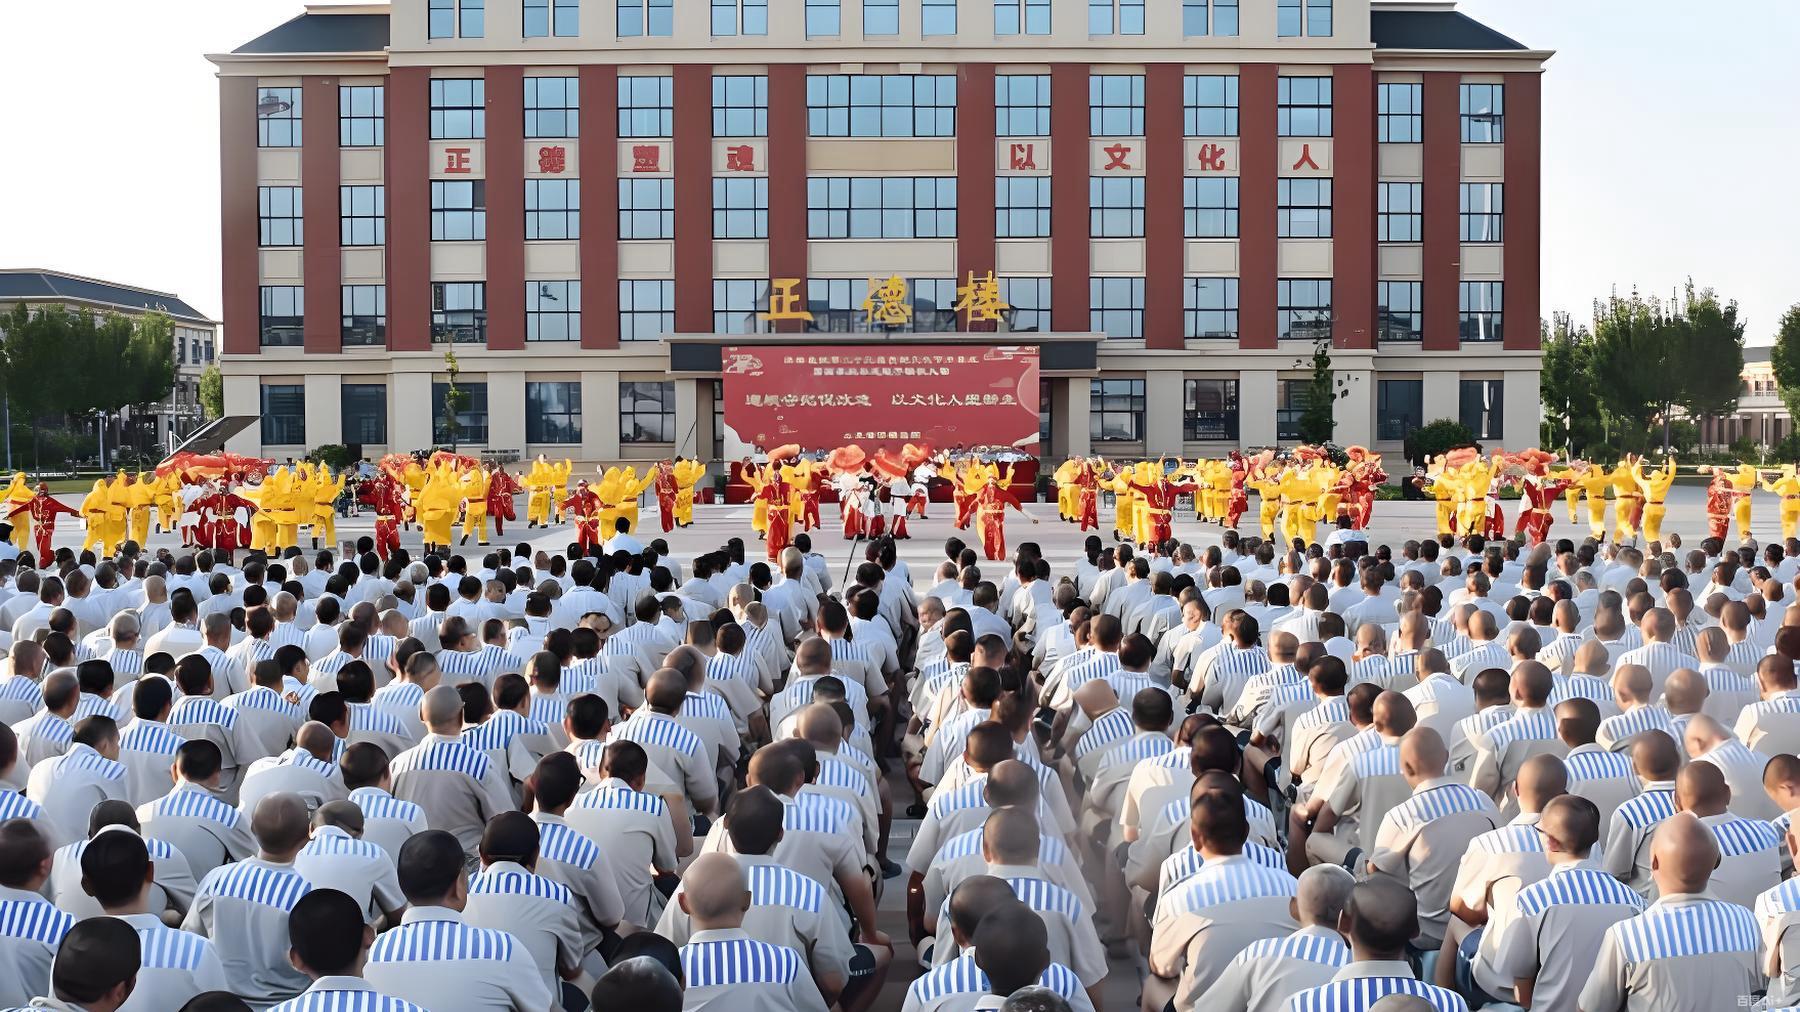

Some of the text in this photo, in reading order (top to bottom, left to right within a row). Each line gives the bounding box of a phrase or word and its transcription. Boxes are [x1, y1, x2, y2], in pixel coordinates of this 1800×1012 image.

[1010, 143, 1320, 171] 以文化人
[758, 270, 1010, 326] 正德楼
